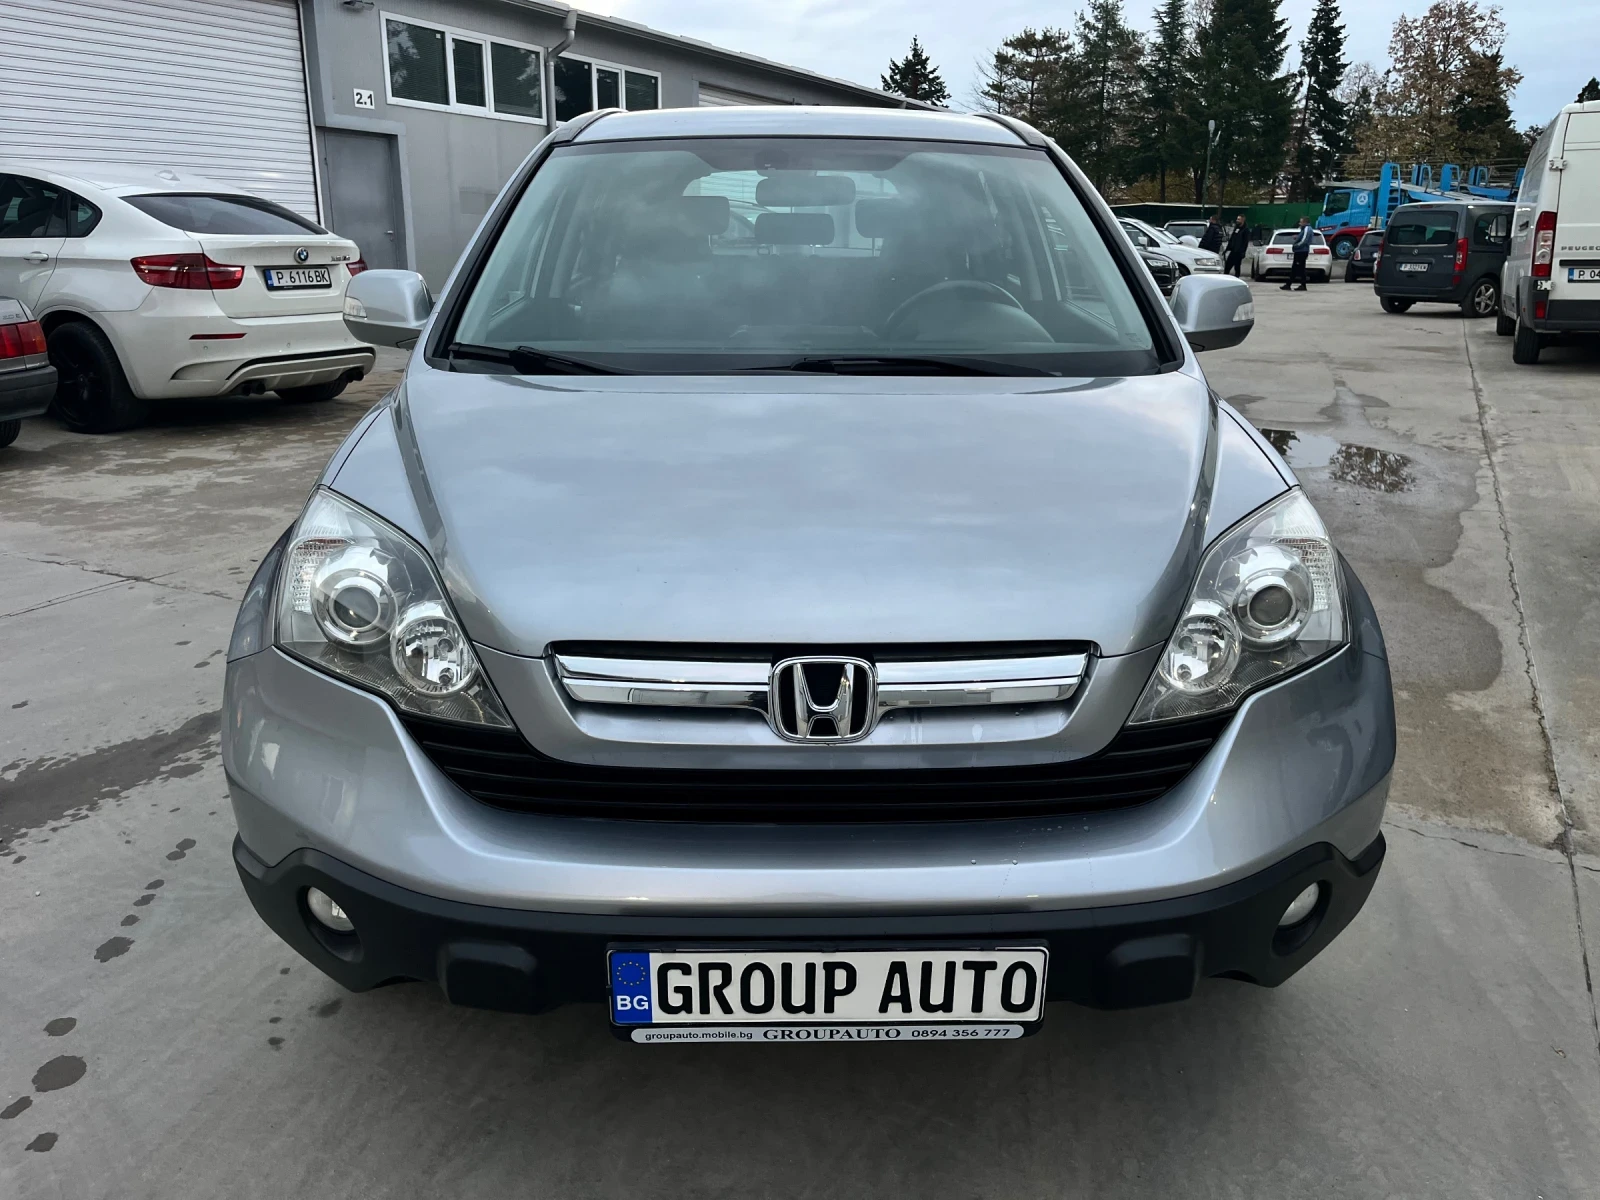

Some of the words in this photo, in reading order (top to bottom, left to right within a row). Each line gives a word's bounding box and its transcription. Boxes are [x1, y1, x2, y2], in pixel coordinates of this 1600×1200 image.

[355, 92, 373, 106] 2.1
[657, 961, 857, 1014] GROUP
[878, 960, 1037, 1013] AUTO
[616, 995, 649, 1011] BG
[645, 1031, 753, 1040] groupauto.mobile.bg
[763, 1029, 901, 1040] GROUPAUTO
[911, 1030, 948, 1038] 0894
[984, 1029, 1010, 1037] 777
